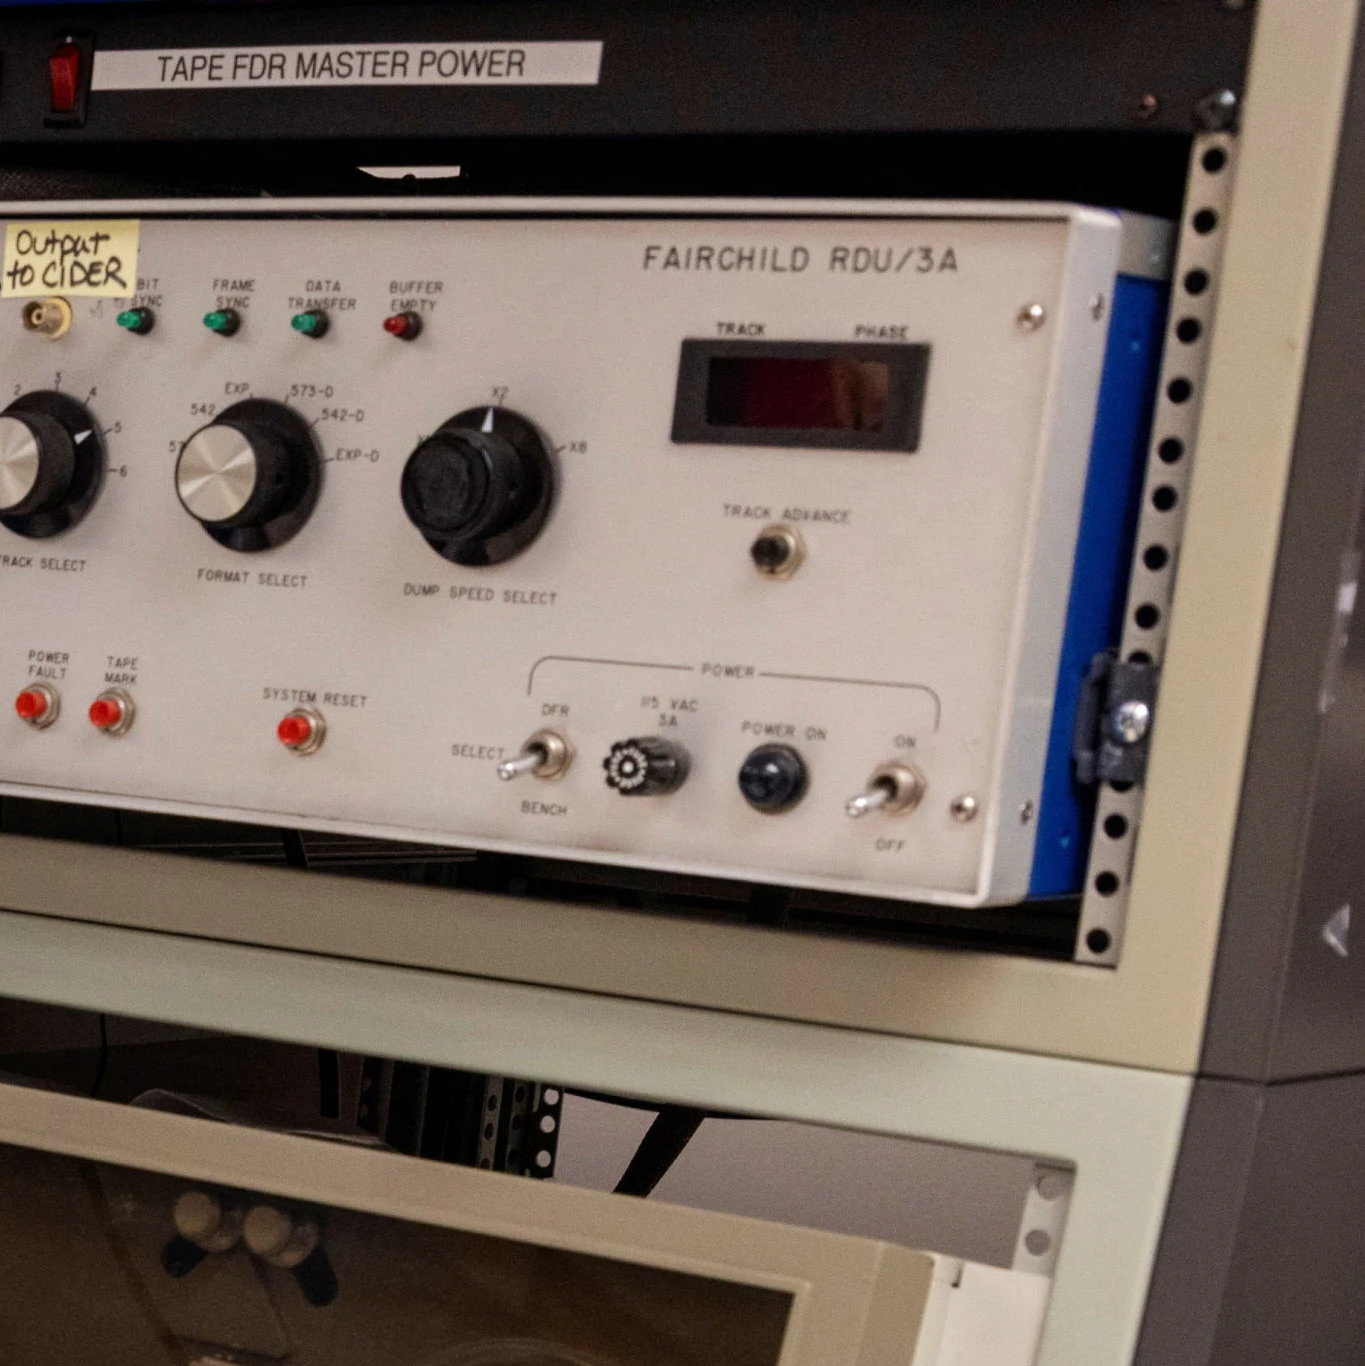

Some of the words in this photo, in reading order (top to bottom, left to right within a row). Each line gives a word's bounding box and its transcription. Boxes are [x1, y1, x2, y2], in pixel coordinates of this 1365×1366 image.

[158, 55, 224, 81] TAPE
[232, 53, 286, 80] FDR
[295, 50, 409, 79] MASTER
[418, 49, 526, 77] POWER
[16, 229, 111, 265] Output
[643, 245, 811, 273] FAIRCHILD
[828, 247, 958, 274] RDU/3A
[7, 260, 34, 288] to
[42, 256, 127, 289] CIDER
[137, 278, 159, 290] BIT
[213, 279, 256, 291] FRAME
[306, 280, 341, 292] DATA
[389, 281, 443, 293] BUFFER
[717, 322, 766, 336] TRACK
[855, 324, 909, 340] PHASE
[225, 382, 249, 394] EXP
[336, 449, 379, 462] EXP-D
[723, 504, 772, 519] TRACK
[782, 507, 851, 523] ADVANCE
[40, 558, 86, 572] SELECT
[197, 569, 249, 584] FORMAT
[258, 573, 308, 588] SELECT
[404, 583, 440, 596] DUMP
[449, 586, 494, 601] SPEED
[503, 590, 557, 605] SELECT
[28, 650, 69, 664] POWER
[107, 656, 138, 670] TAPE
[28, 666, 67, 680] FAULT
[700, 663, 756, 679] POWER
[105, 672, 138, 685] MARK
[263, 688, 317, 703] SYSTEM
[323, 694, 368, 708] RESET
[520, 801, 568, 817] BENCH
